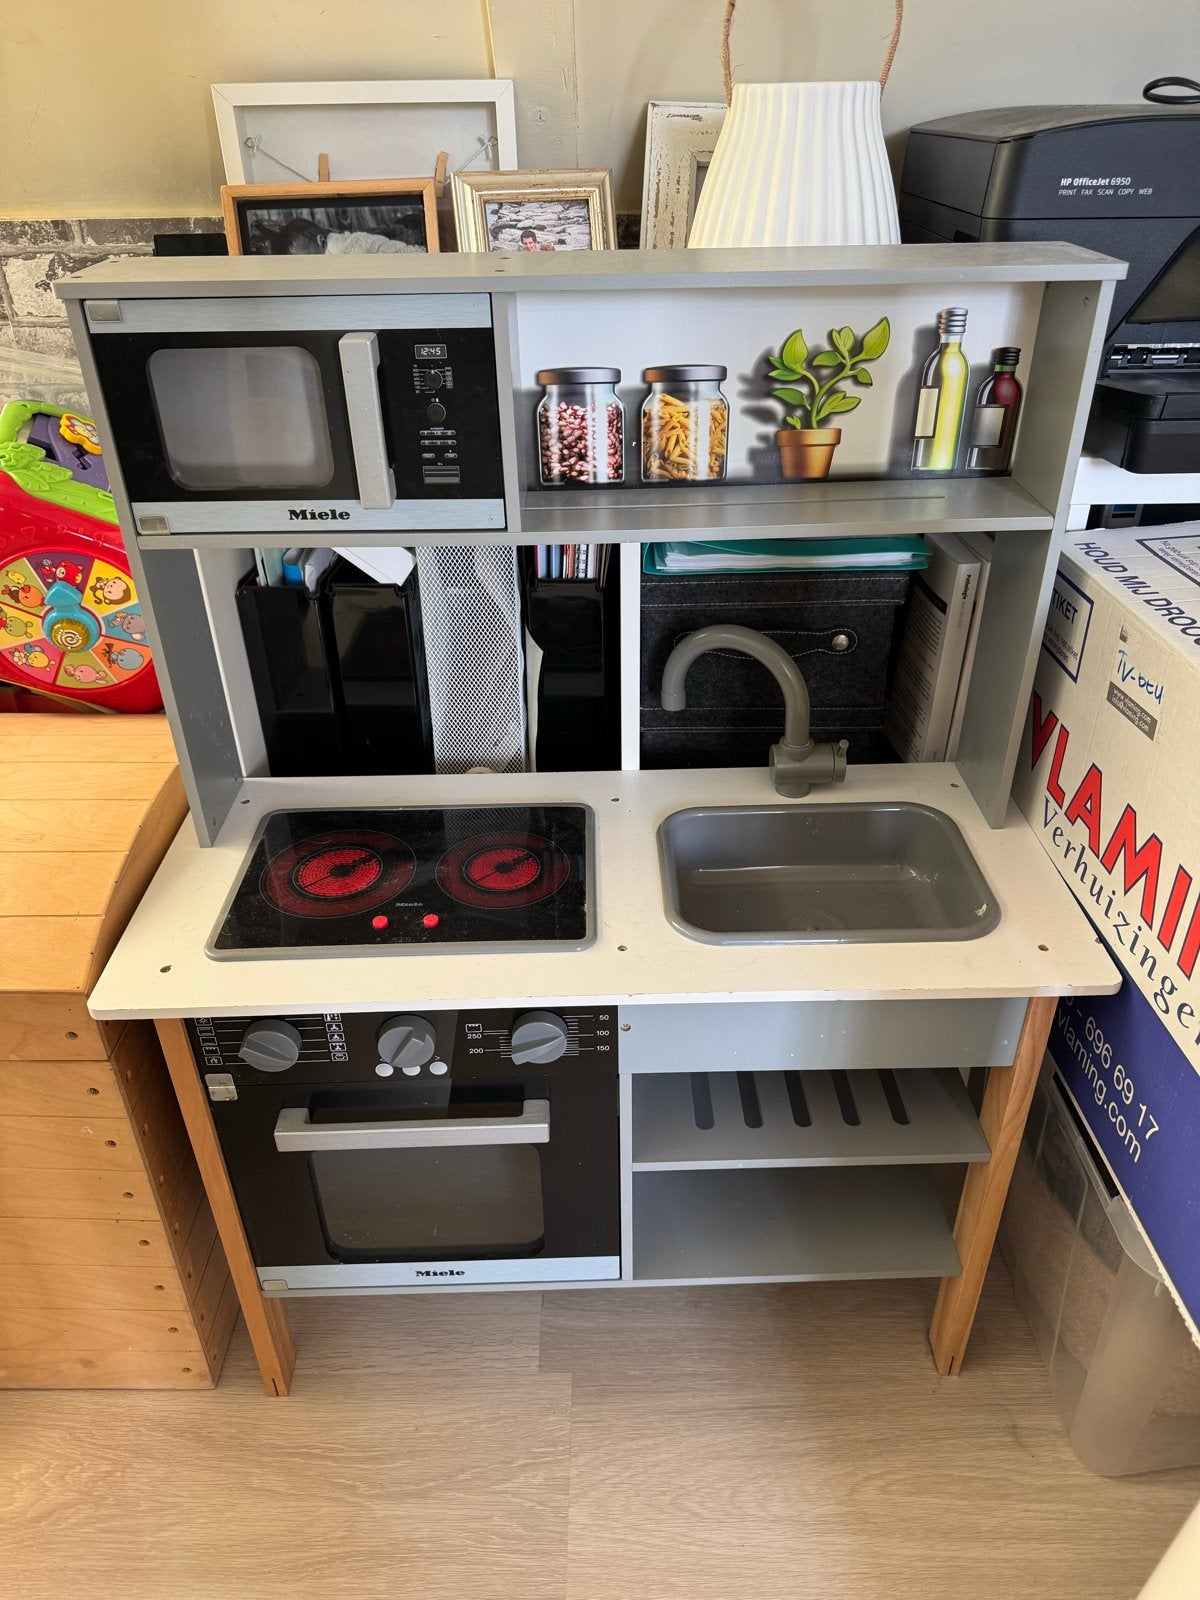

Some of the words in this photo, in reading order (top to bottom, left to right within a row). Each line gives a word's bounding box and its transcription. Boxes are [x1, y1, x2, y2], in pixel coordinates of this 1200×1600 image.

[1060, 178, 1072, 186] HP
[1073, 177, 1109, 186] OfficeJet
[1110, 177, 1131, 186] 6950
[420, 347, 441, 355] 12:45
[288, 509, 350, 520] Miele
[1052, 587, 1078, 624] TIKET
[1074, 542, 1128, 573] HOUD
[1114, 575, 1160, 595] MIJ
[1142, 598, 1200, 646] DROO
[1044, 796, 1200, 1045] Verhuizinge
[1085, 1016, 1112, 1069] 696
[1113, 1064, 1134, 1105] 69
[1137, 1102, 1159, 1140] 17
